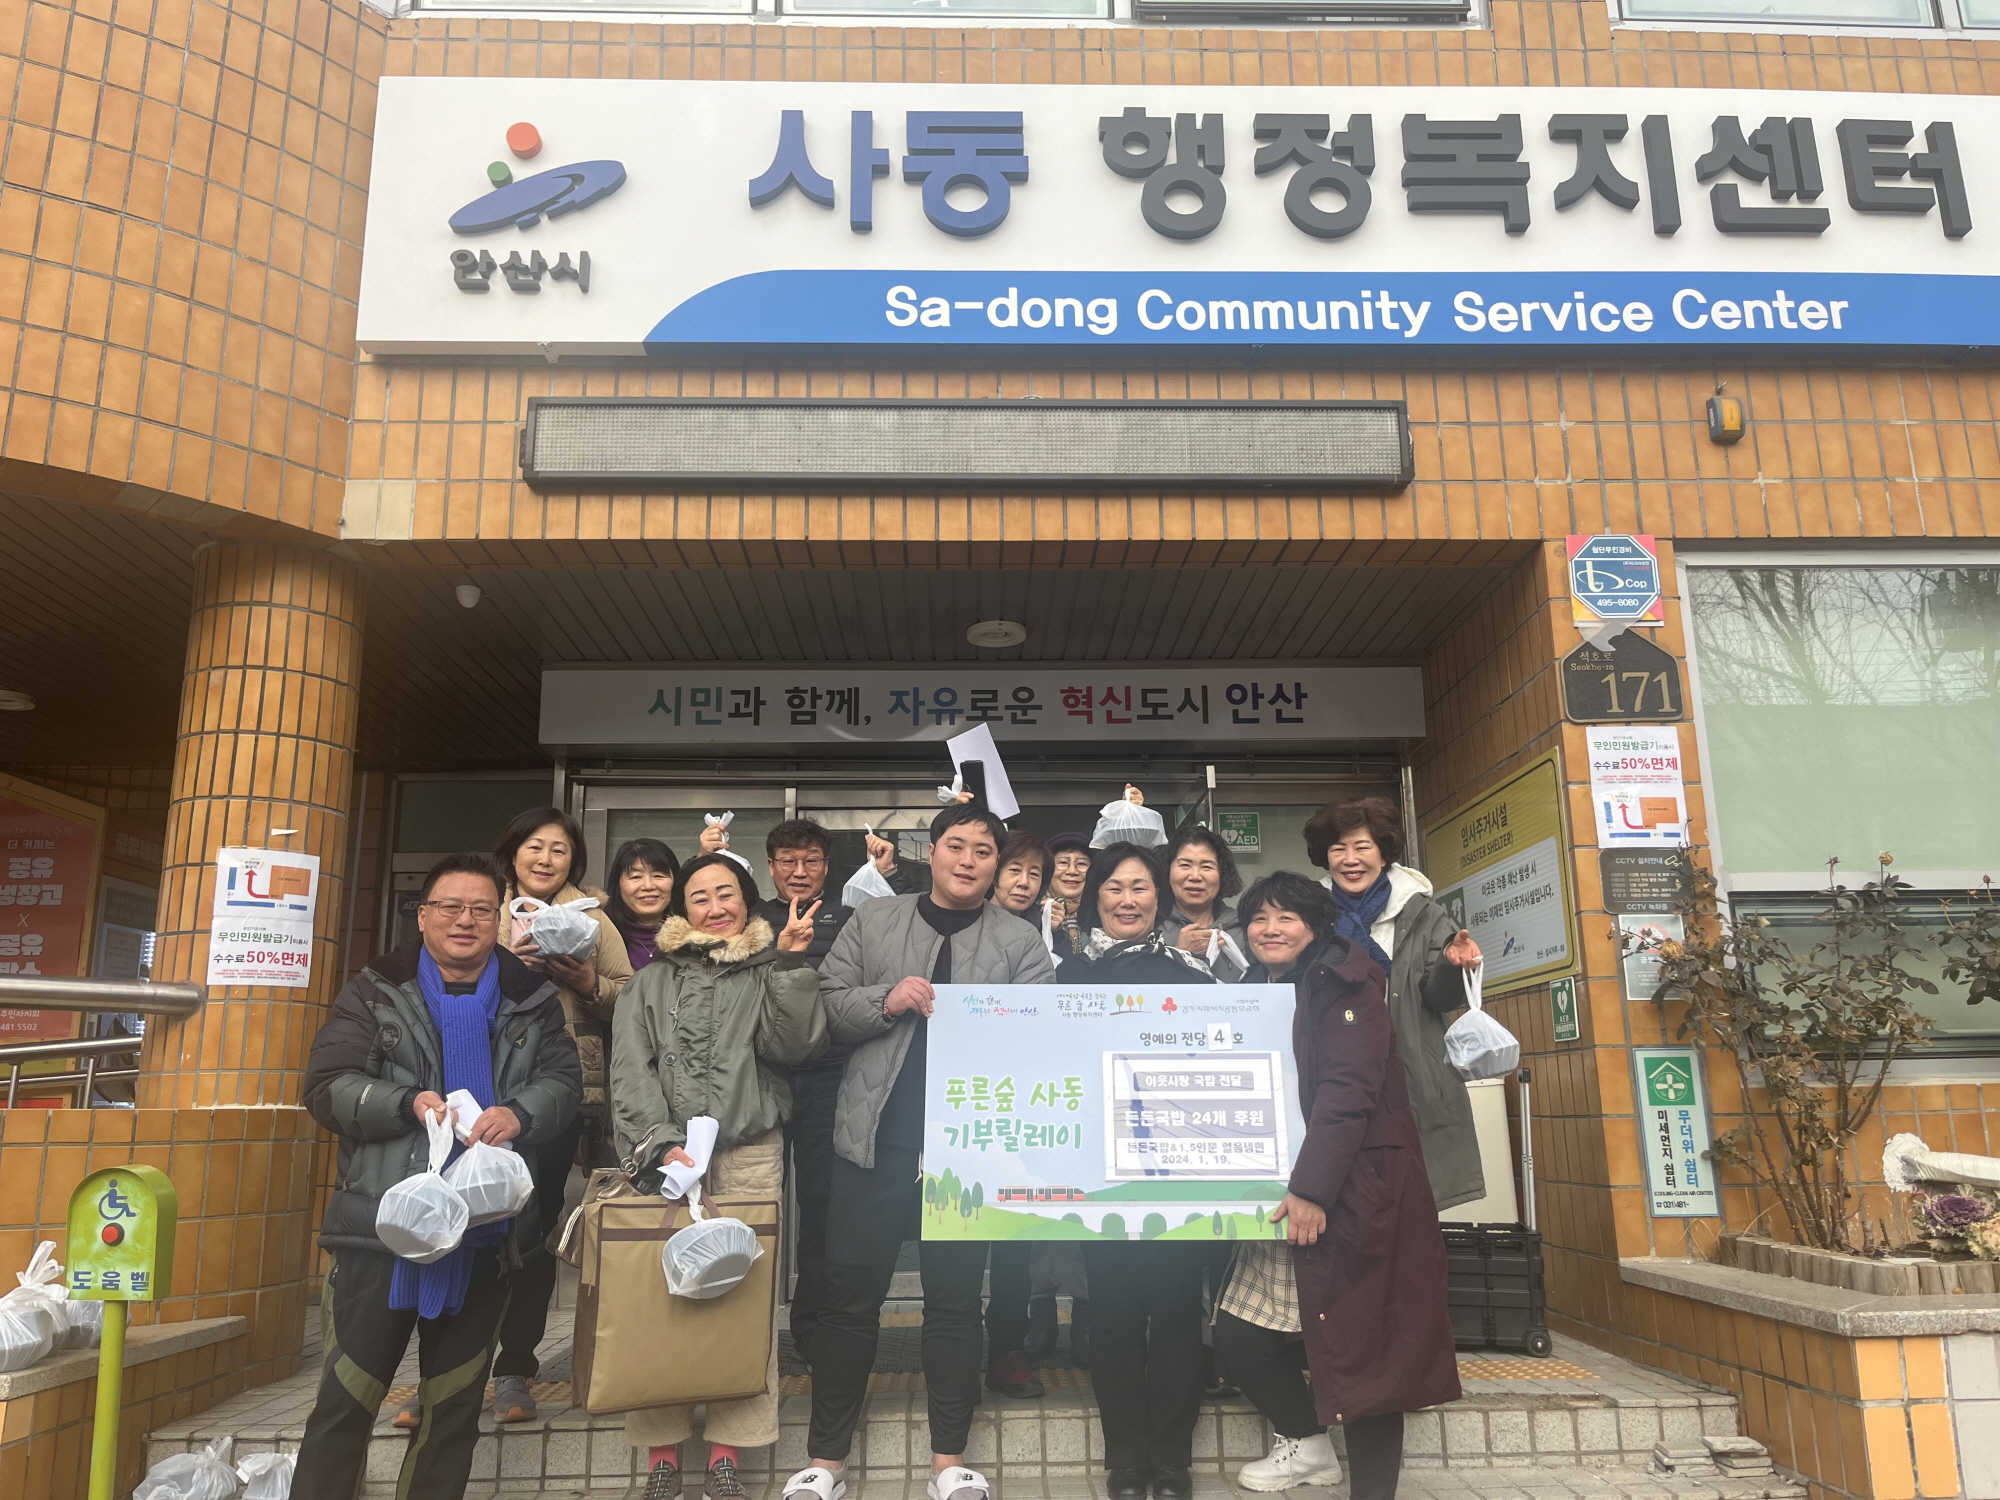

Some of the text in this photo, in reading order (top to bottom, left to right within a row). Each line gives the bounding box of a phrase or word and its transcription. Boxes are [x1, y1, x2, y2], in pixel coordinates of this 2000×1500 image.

[749, 107, 1973, 240] 사동 행정복지센터
[449, 249, 591, 293] 안산시
[886, 286, 1849, 338] Sa-dong Community Service Center
[1625, 579, 1647, 588] Cop
[1570, 663, 1614, 671] Seokho-ro
[1580, 651, 1614, 662] 석호로
[1601, 671, 1677, 713] 171
[647, 682, 1308, 727] 시민과 함께, 자유로운 혁신도시 안산
[1461, 802, 1508, 848] 임시주거시설
[7, 839, 55, 849] 더 커지는
[1237, 835, 1258, 845] AED
[1487, 830, 1513, 856] SHELTER)
[8, 857, 55, 879] 공유
[1482, 880, 1495, 896] 이곳은
[1531, 861, 1537, 876] 시
[0, 884, 64, 906] 냉장고
[0, 934, 44, 957] 공유
[218, 932, 293, 944] 무인민원발급기
[1139, 1029, 1244, 1047] 영예의 전당 4 호
[1145, 1075, 1242, 1087] 이웃사랑 국밥 전달
[945, 1075, 1084, 1112] 푸른숲 사동
[1125, 1110, 1264, 1127] 든든국밥 24개 후원
[944, 1117, 1082, 1152] 기부릴레이
[1162, 1155, 1231, 1165] 2024. 1. 19.
[1657, 1110, 1676, 1188] 미세먼지 쉼터
[1678, 1109, 1699, 1188] 무더위 쉼터
